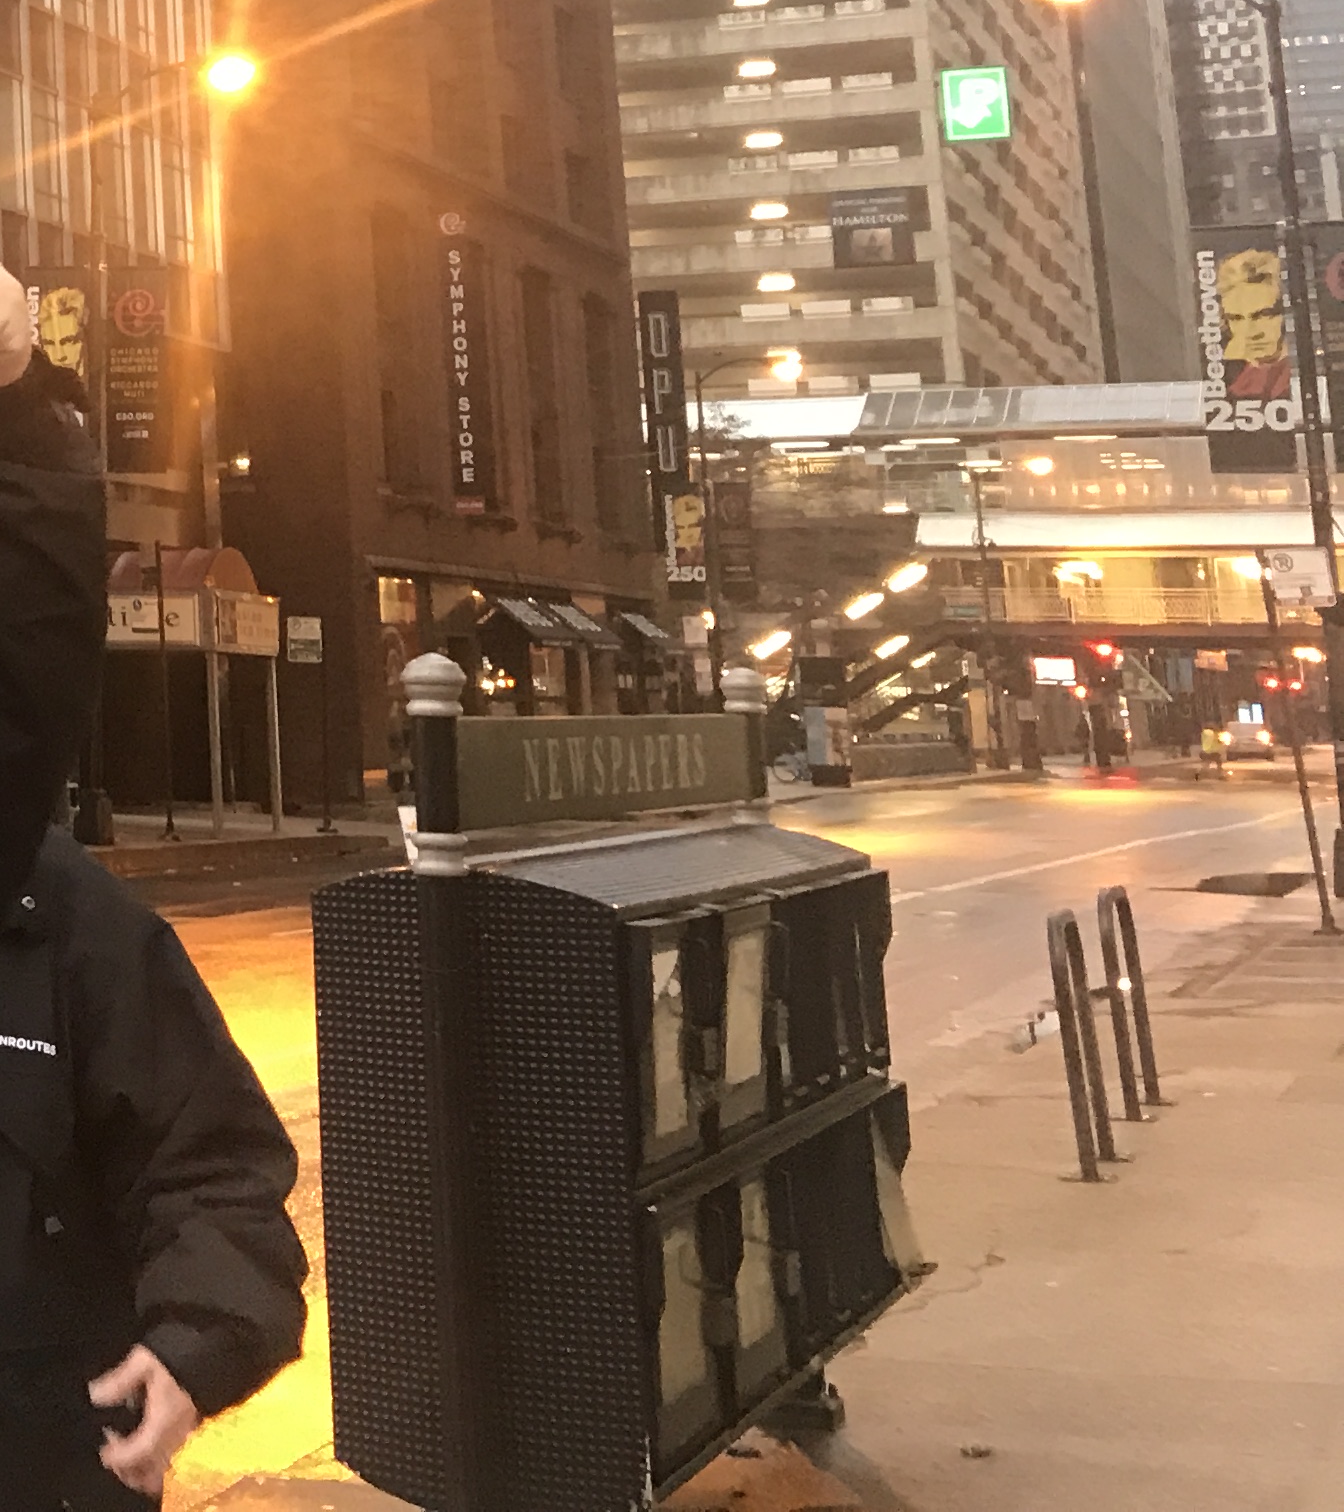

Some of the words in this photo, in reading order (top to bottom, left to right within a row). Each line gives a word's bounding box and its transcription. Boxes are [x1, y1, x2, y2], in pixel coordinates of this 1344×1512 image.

[448, 249, 469, 387] SYMPHONY
[1196, 250, 1227, 402] Beethoven
[458, 396, 475, 483] STORE
[1205, 399, 1297, 432] 250
[667, 566, 706, 582] 250
[522, 733, 707, 803] NEWSPAPERS
